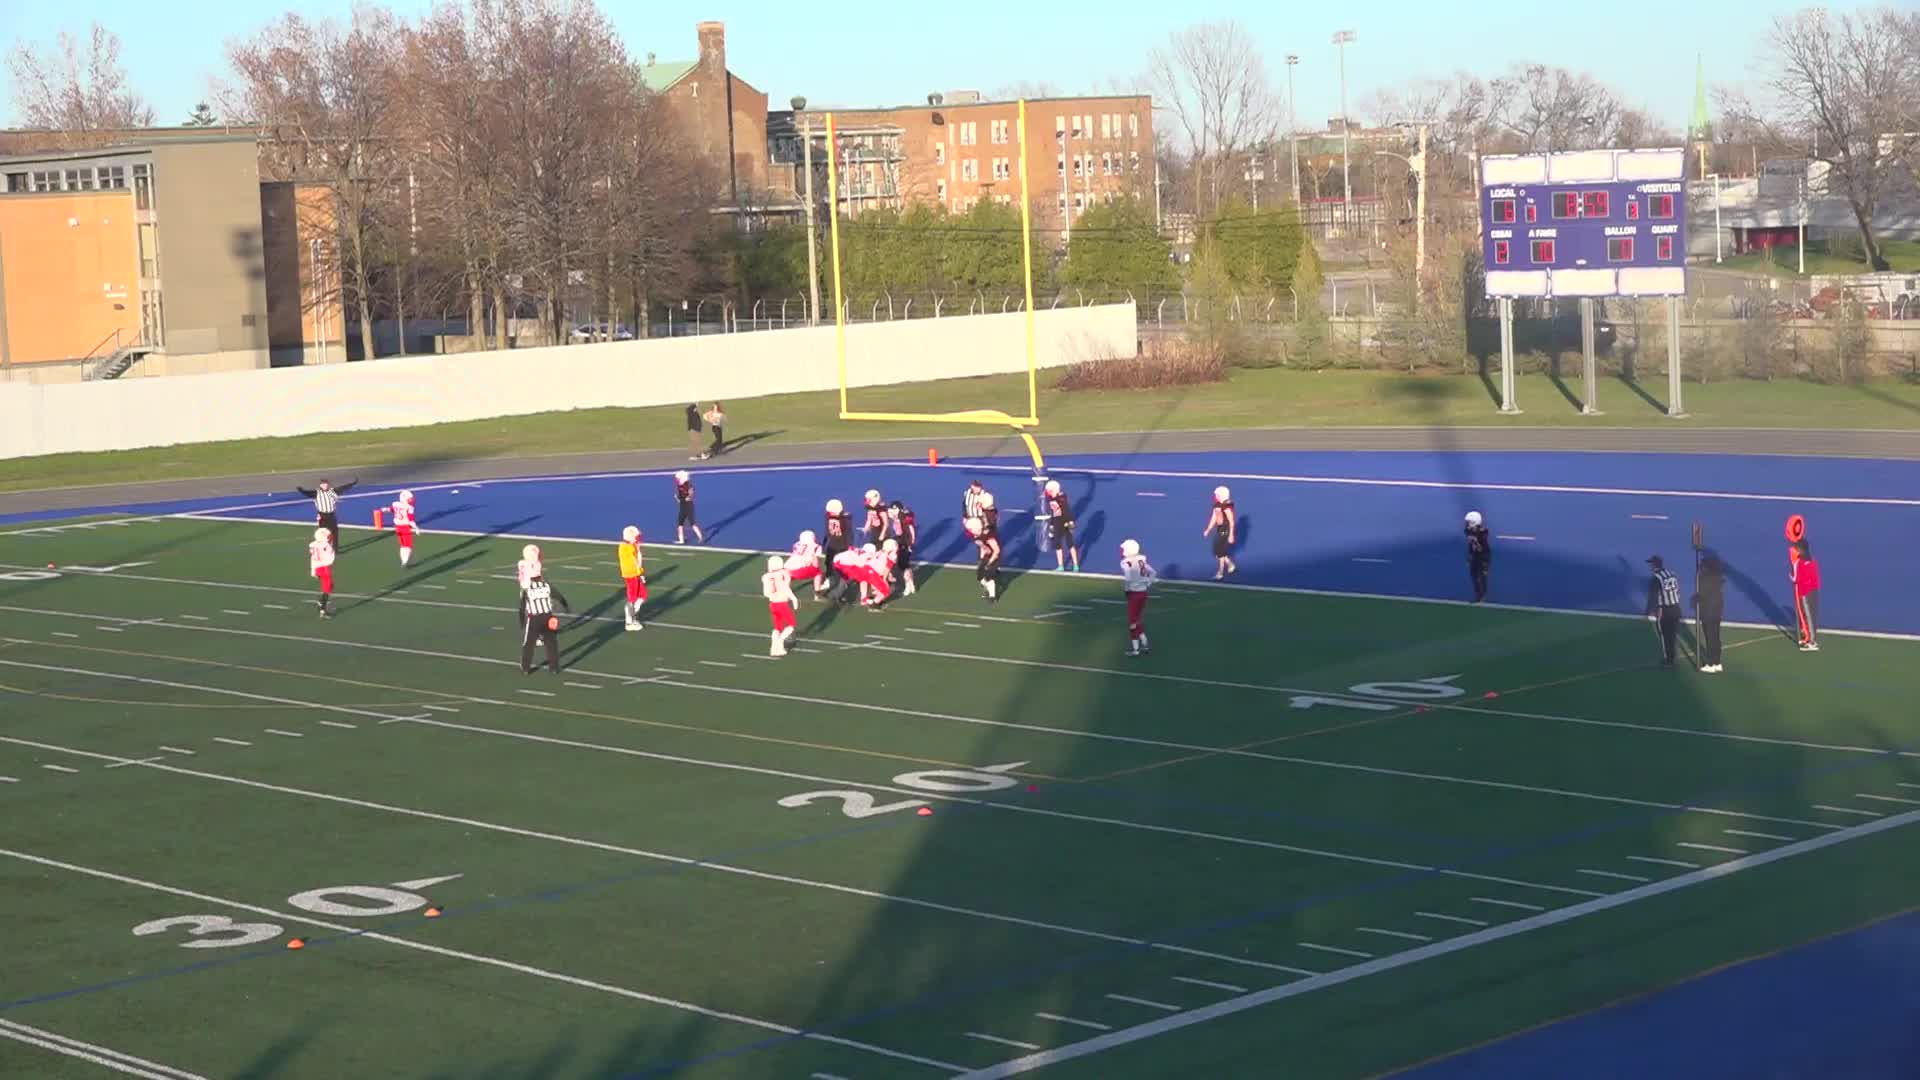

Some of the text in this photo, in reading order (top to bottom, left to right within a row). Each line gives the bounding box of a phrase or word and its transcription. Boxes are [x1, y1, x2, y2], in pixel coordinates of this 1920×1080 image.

[1490, 188, 1516, 198] LOCAL
[1642, 183, 1682, 193] VISITEUR
[1605, 226, 1637, 236] BALLON
[777, 770, 1018, 817] 20
[132, 885, 424, 948] 30
